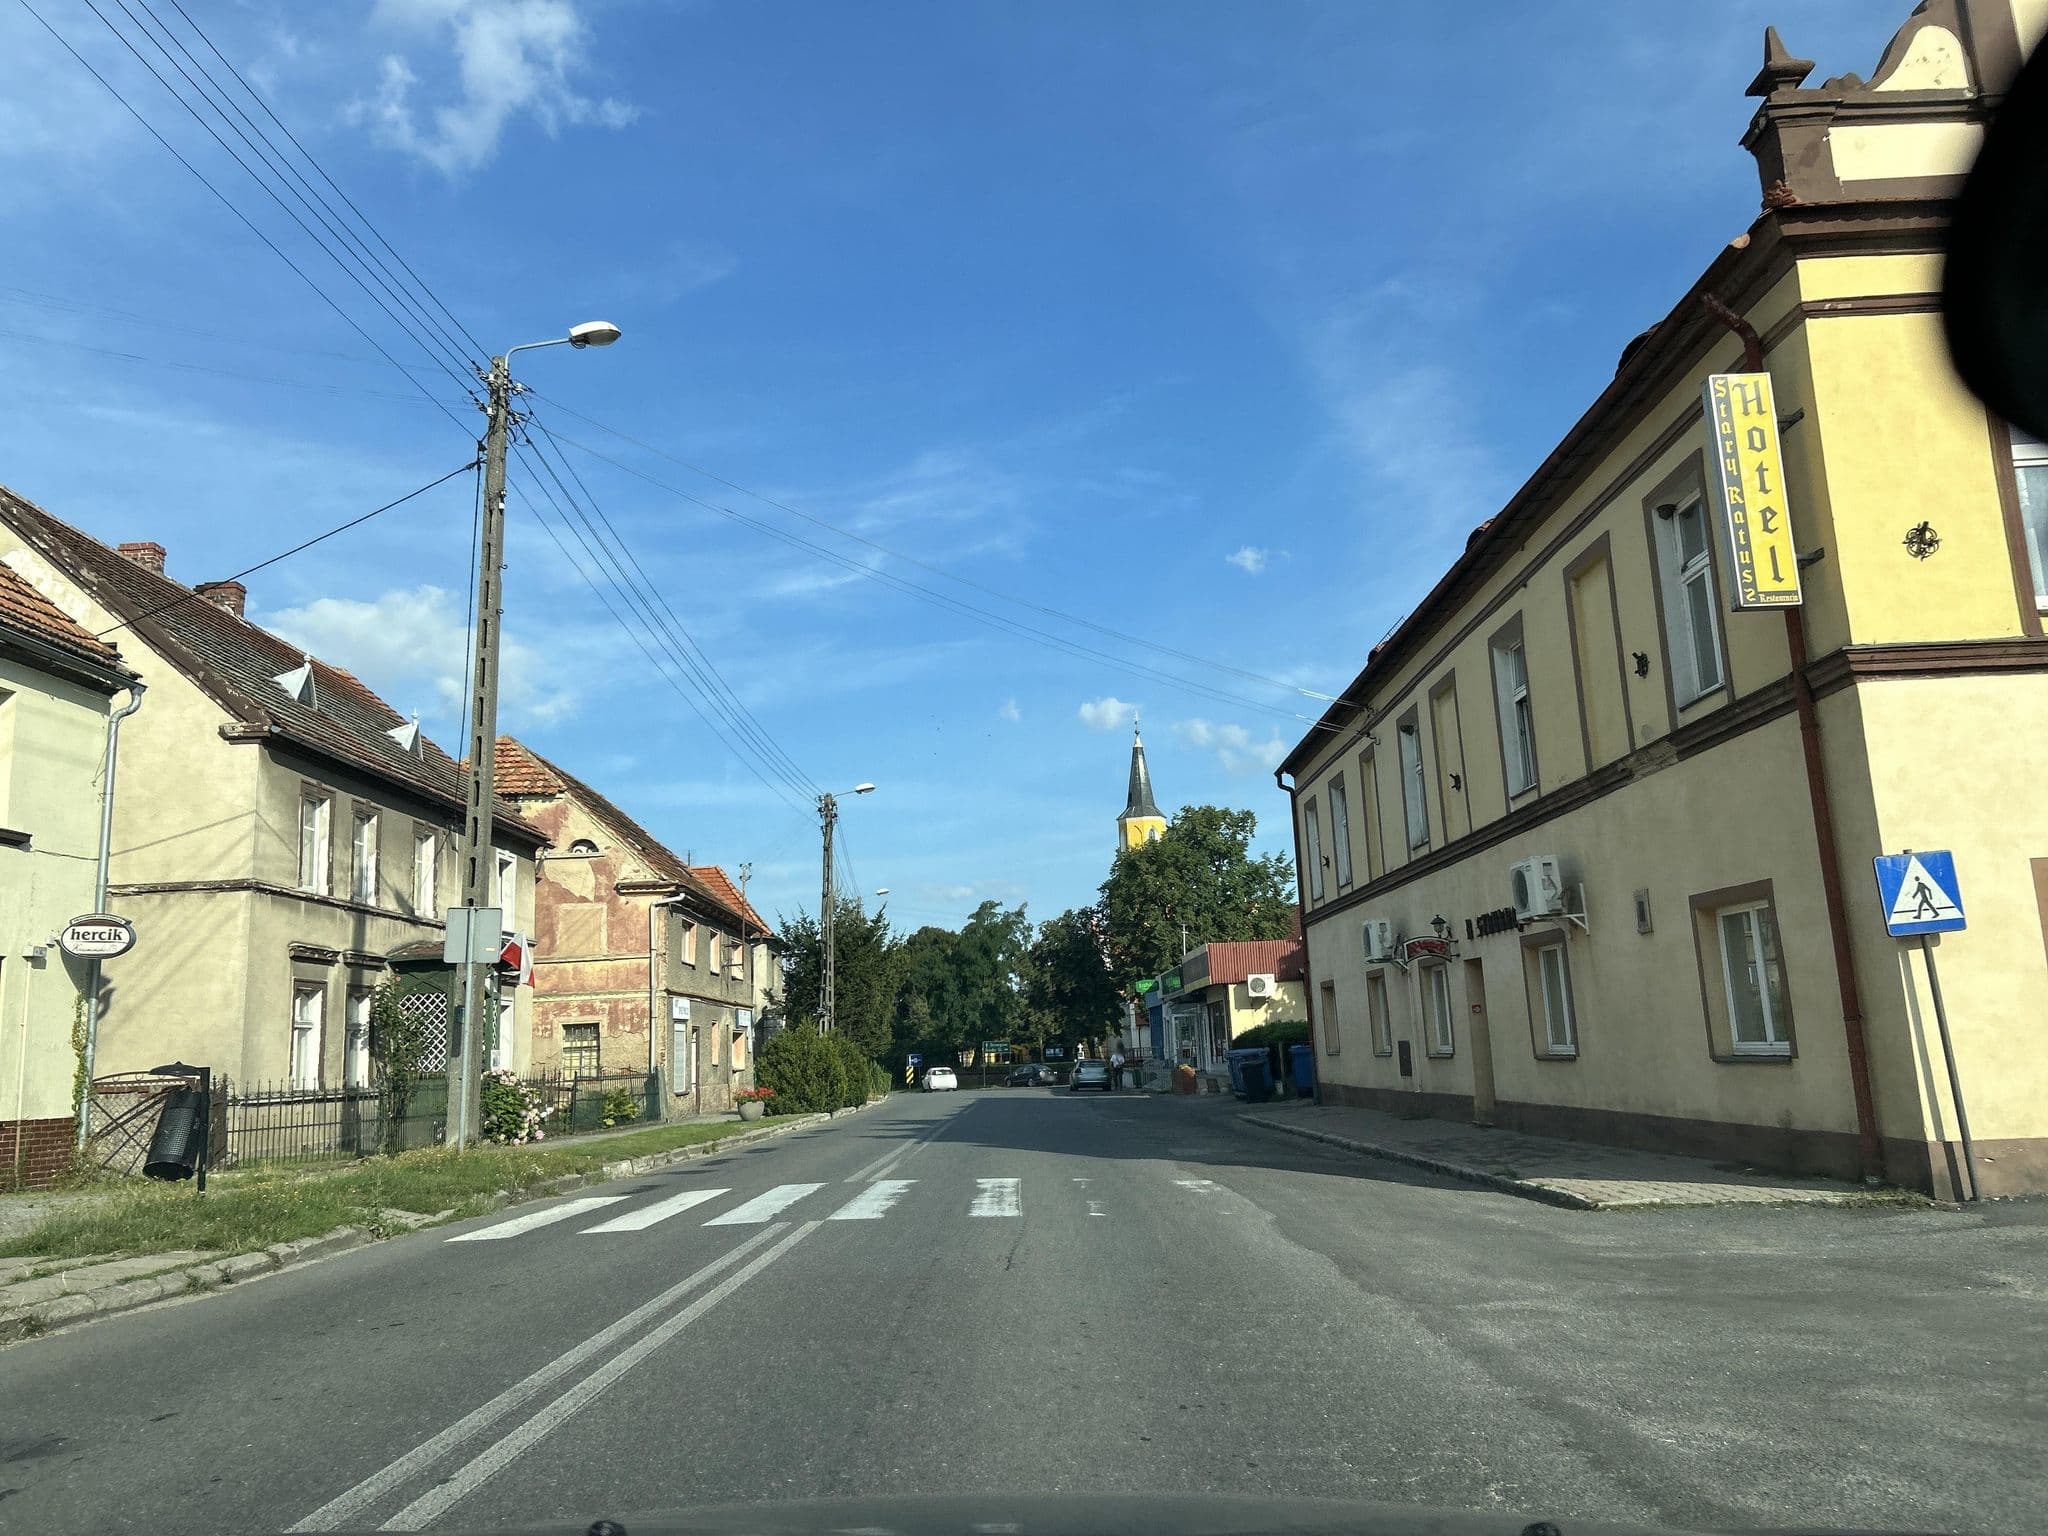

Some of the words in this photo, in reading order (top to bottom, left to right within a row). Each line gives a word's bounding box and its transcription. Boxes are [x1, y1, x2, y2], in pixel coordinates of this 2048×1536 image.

[1713, 378, 1738, 477] Stary
[1732, 379, 1785, 583] Hotel
[70, 928, 123, 941] hercik
